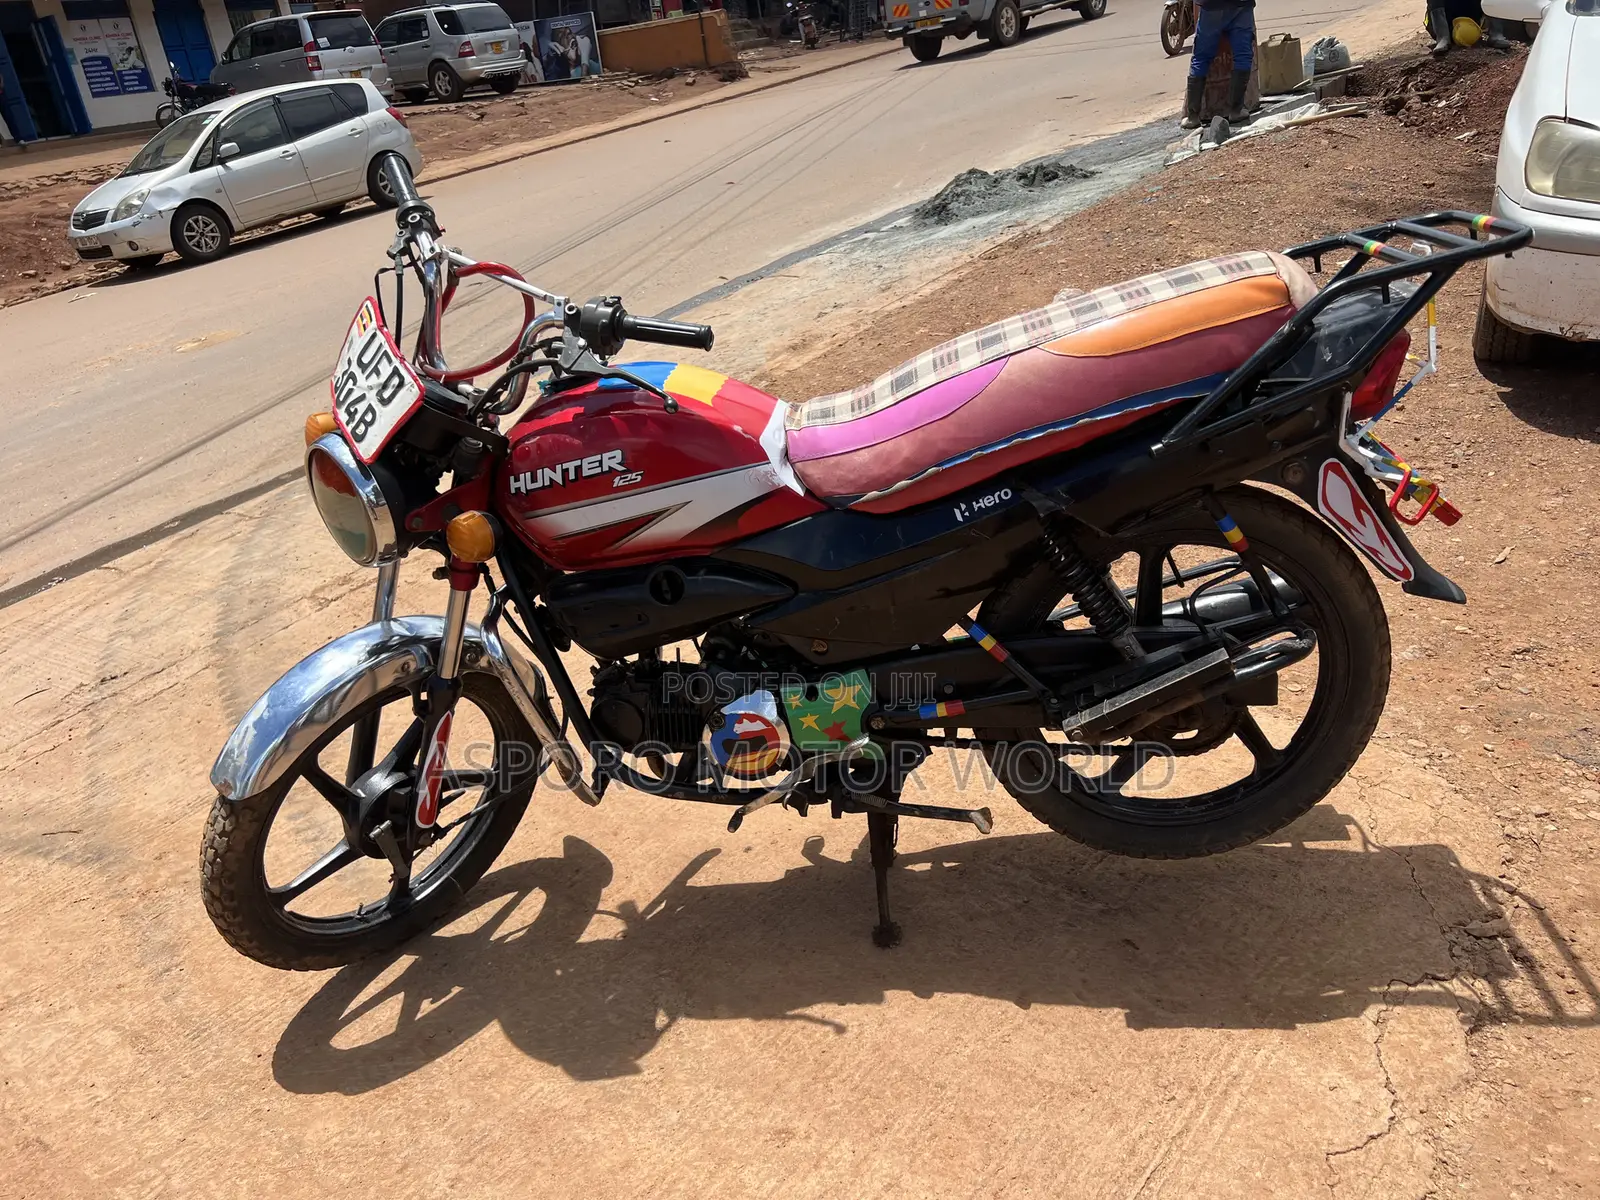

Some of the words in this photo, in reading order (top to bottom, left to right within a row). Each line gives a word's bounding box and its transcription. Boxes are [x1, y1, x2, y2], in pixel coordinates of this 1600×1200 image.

[356, 330, 406, 408] UFD
[334, 356, 377, 444] 304B
[509, 449, 629, 495] HUNTER
[612, 470, 644, 488] 125
[972, 488, 1012, 512] Hero
